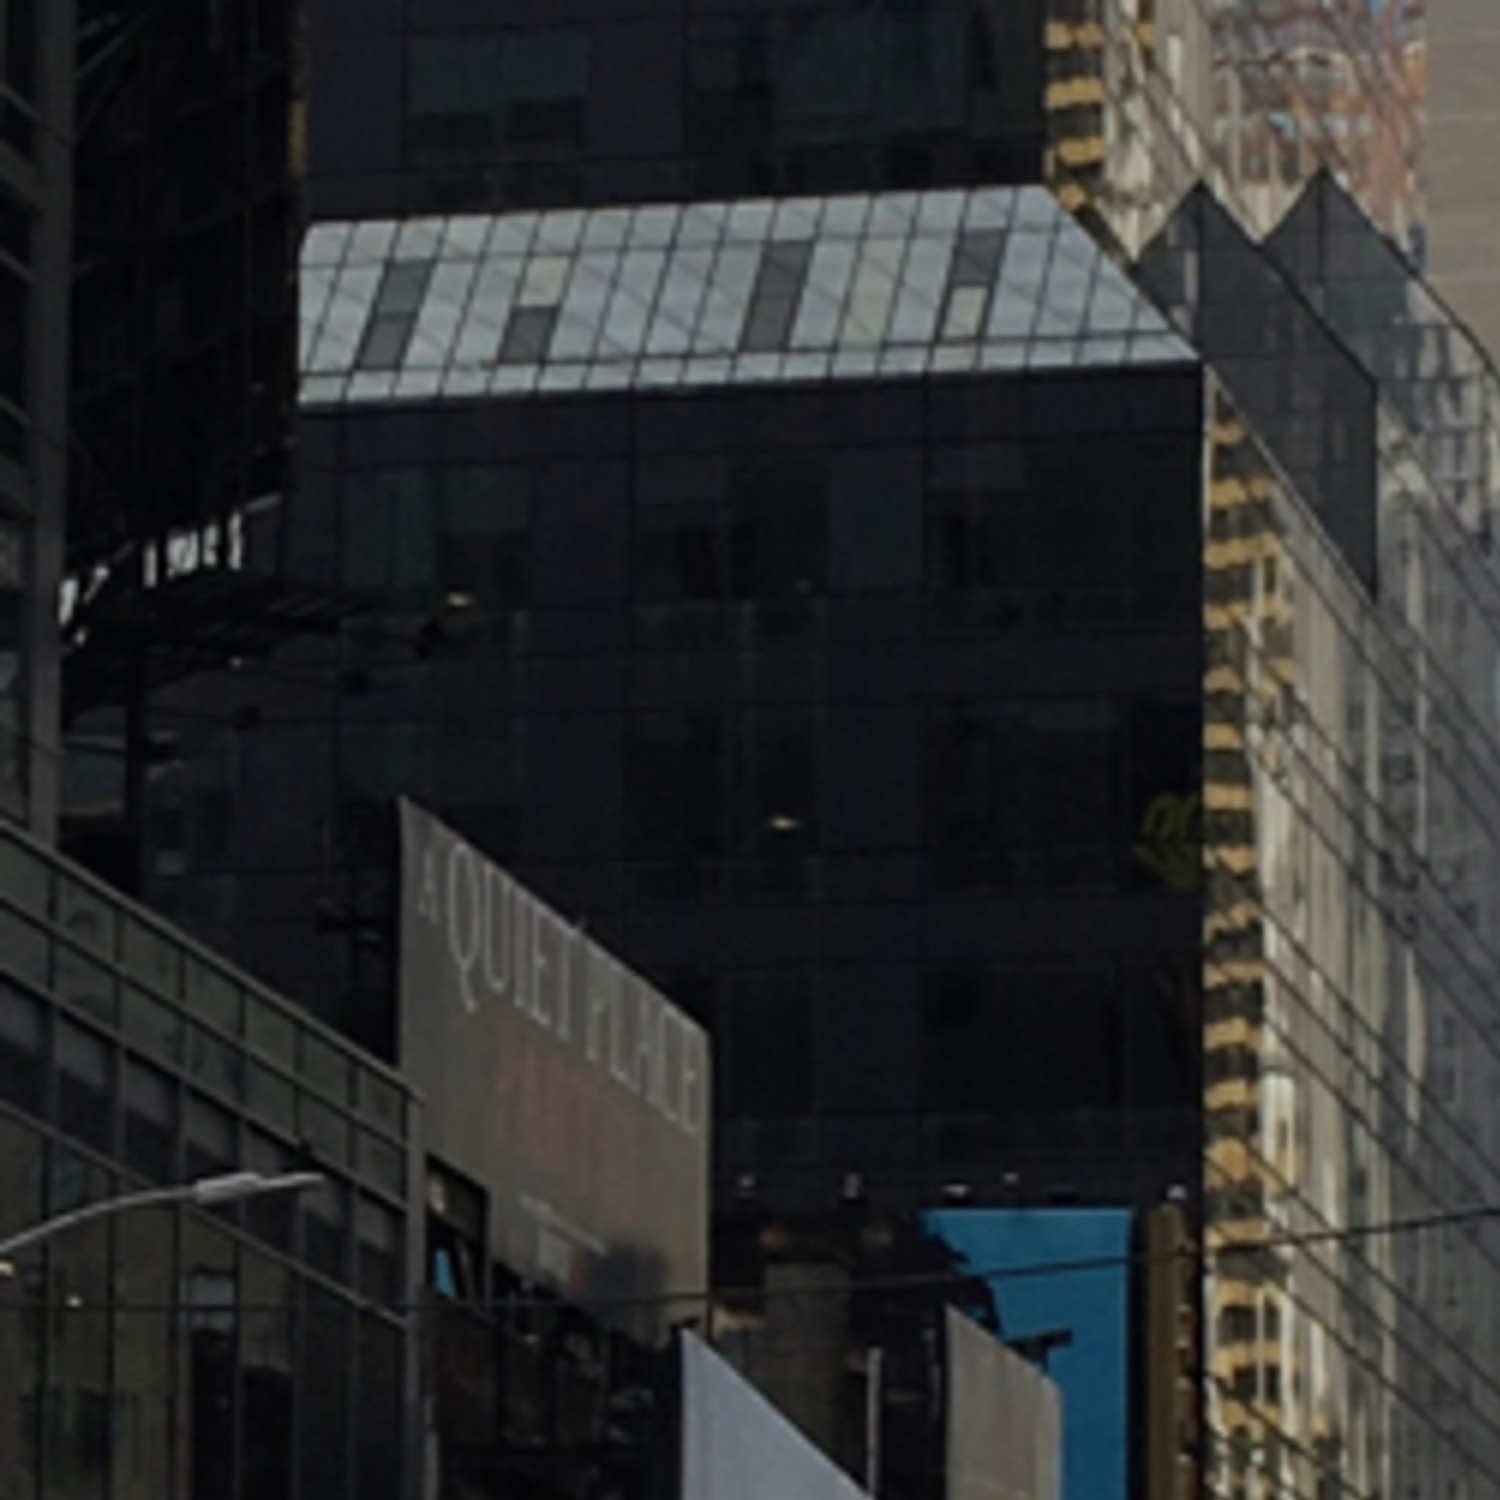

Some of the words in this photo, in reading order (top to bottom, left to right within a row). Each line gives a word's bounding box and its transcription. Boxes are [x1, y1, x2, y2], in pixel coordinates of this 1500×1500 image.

[417, 846, 440, 925] A
[446, 842, 581, 1043] QUIET
[584, 940, 705, 1135] PLACE
